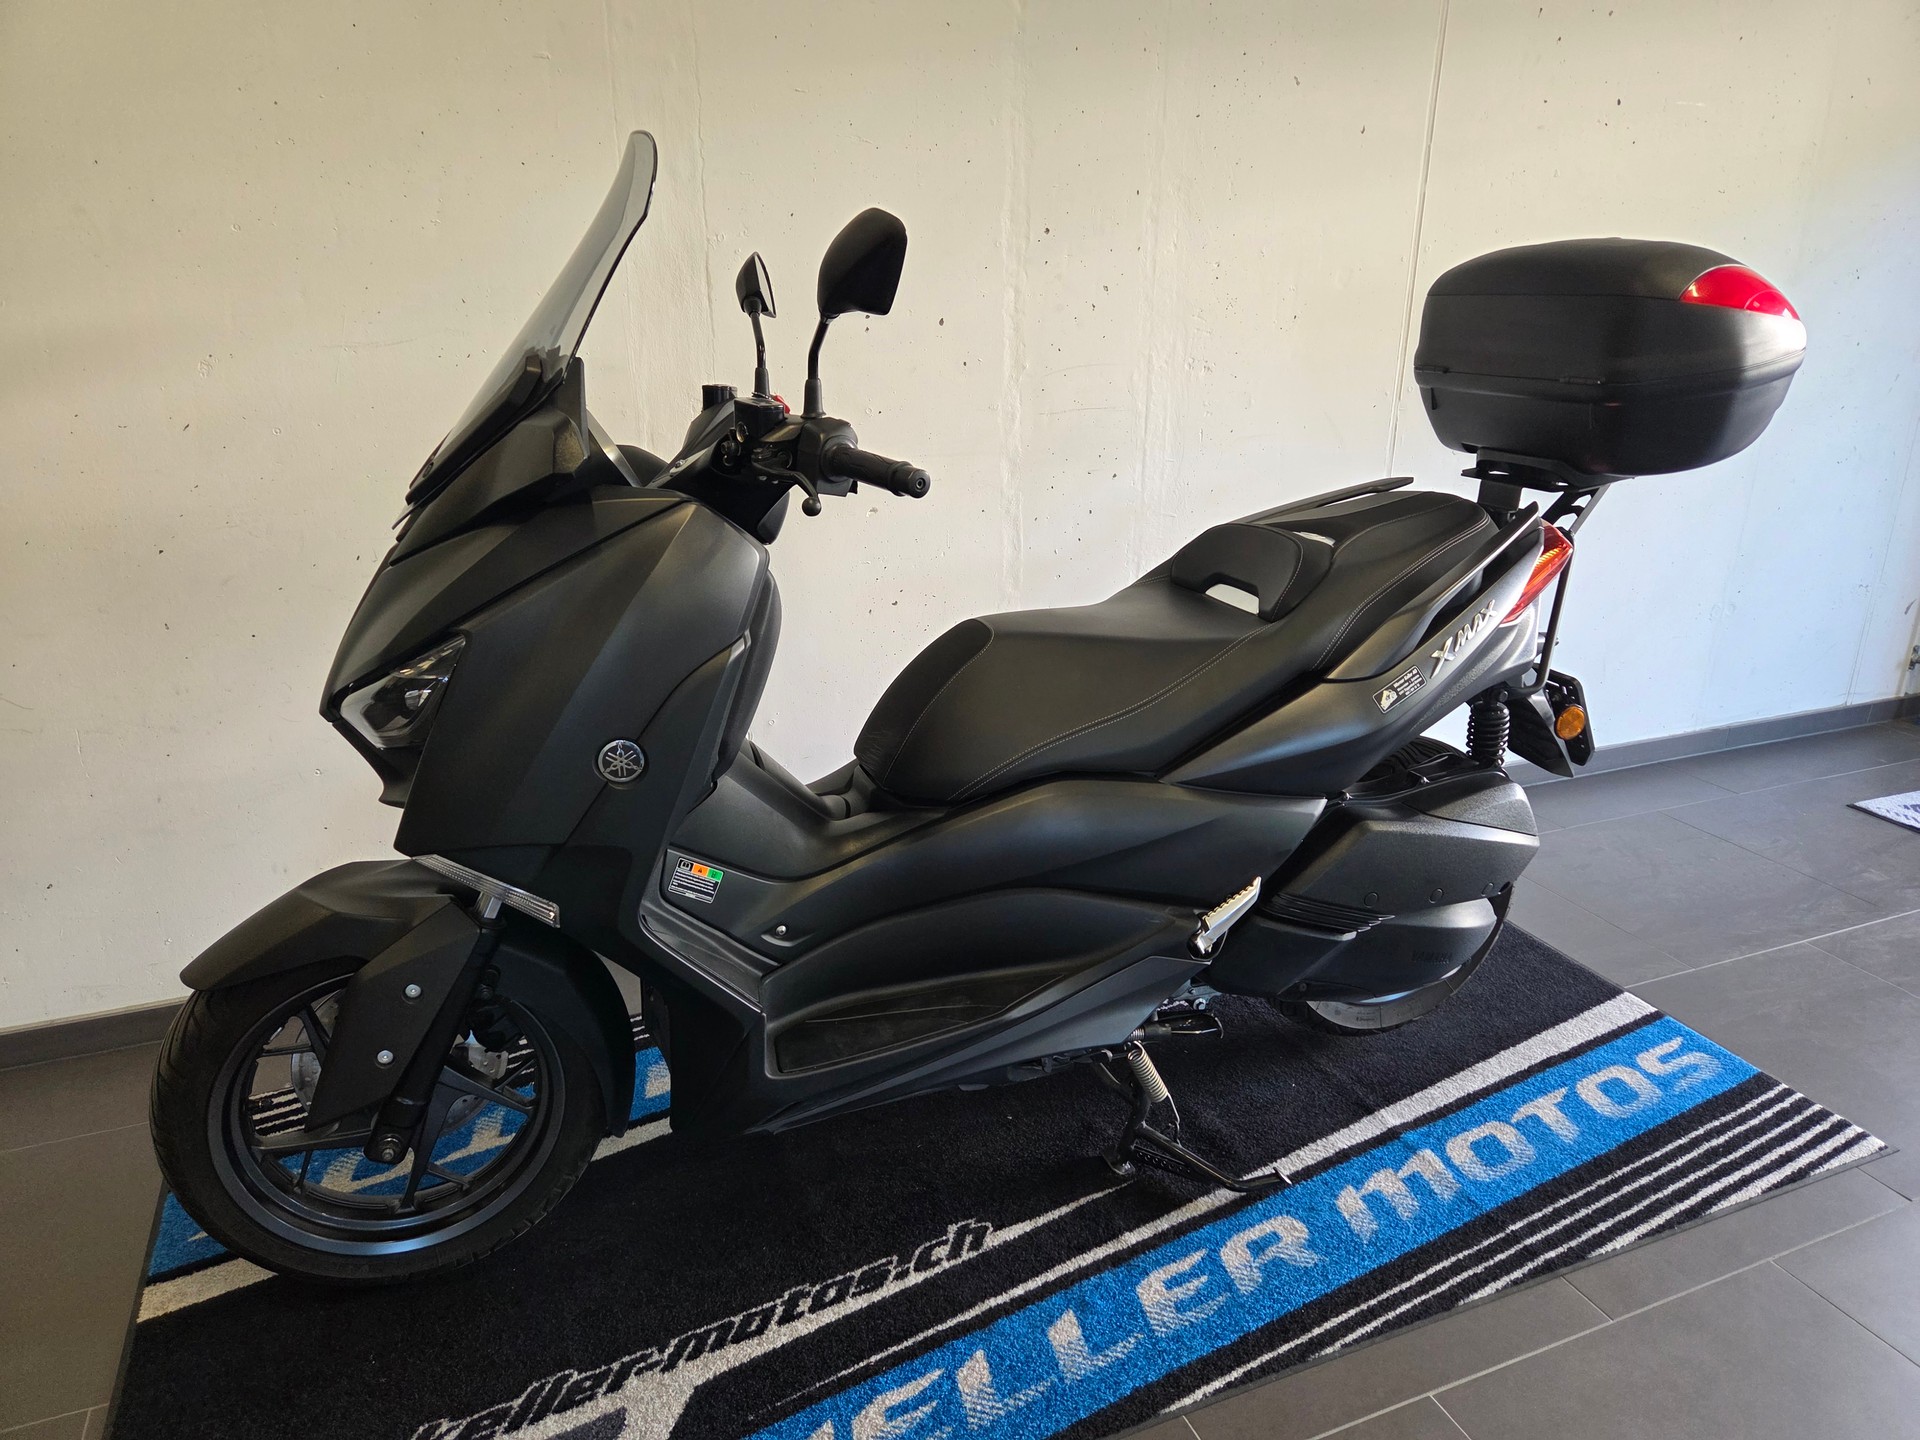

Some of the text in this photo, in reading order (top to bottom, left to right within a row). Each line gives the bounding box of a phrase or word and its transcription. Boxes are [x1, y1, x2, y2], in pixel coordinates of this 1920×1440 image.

[1429, 599, 1498, 679] XMAX
[804, 1036, 1723, 1440] ELLER MOTOS
